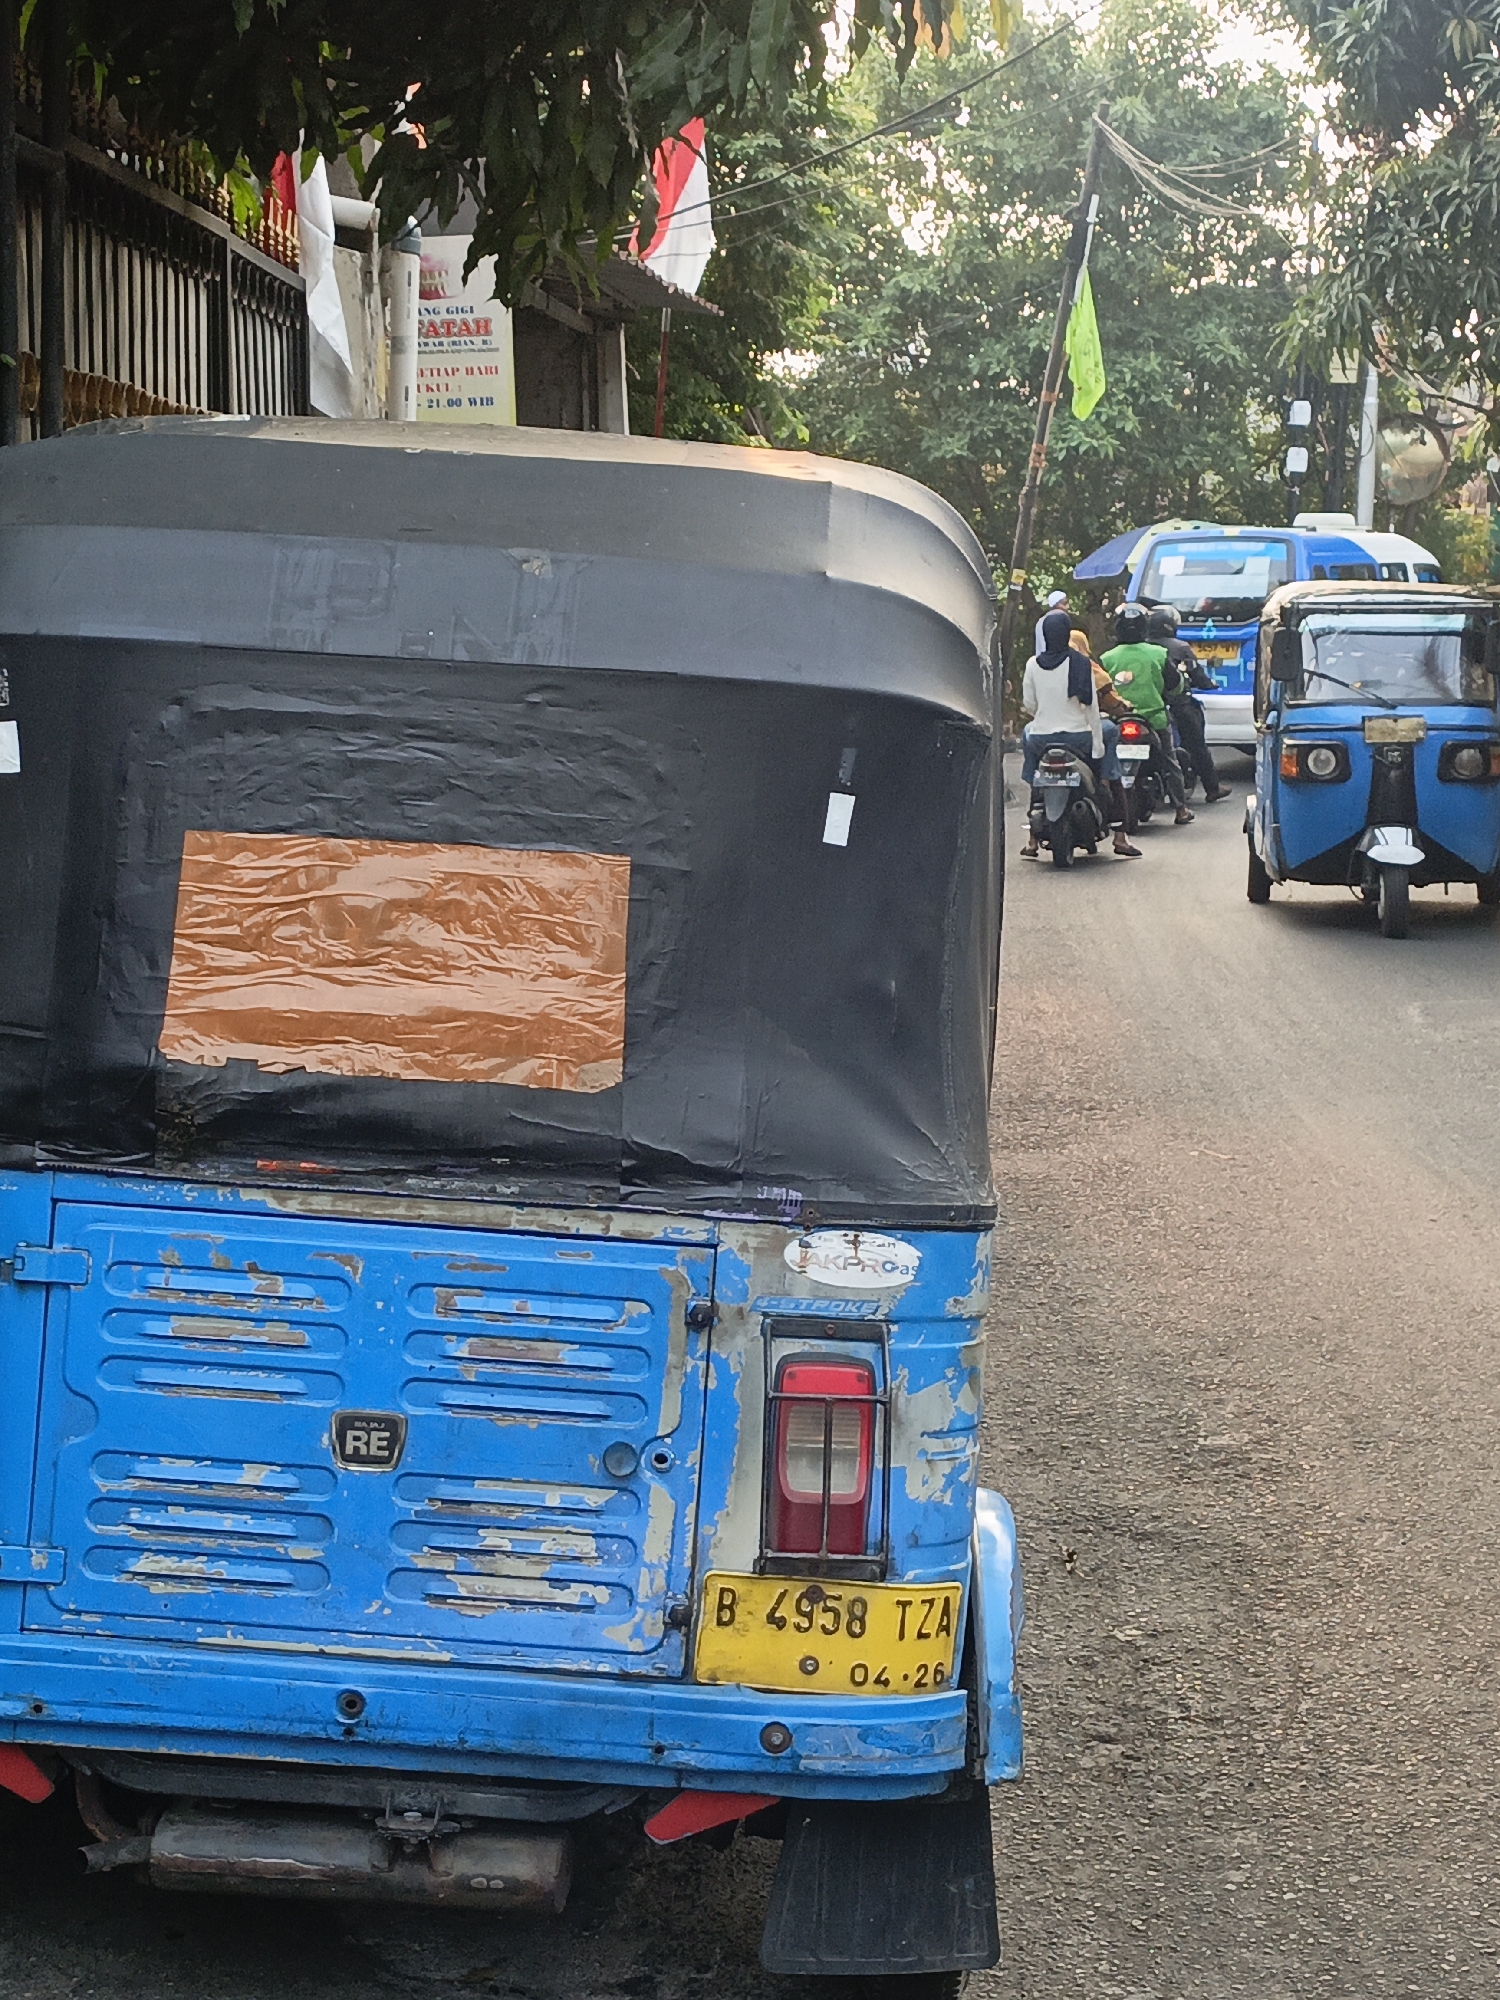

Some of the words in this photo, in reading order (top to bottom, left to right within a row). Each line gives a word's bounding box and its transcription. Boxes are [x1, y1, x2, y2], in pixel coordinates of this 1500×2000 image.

[445, 305, 475, 315] GIGI
[464, 365, 499, 376] HARI
[467, 396, 494, 407] WIB
[755, 1297, 880, 1313] 4-STROKE
[345, 1429, 391, 1457] RE
[716, 1586, 738, 1627] B
[765, 1588, 868, 1639] 4958
[895, 1595, 951, 1641] TZA
